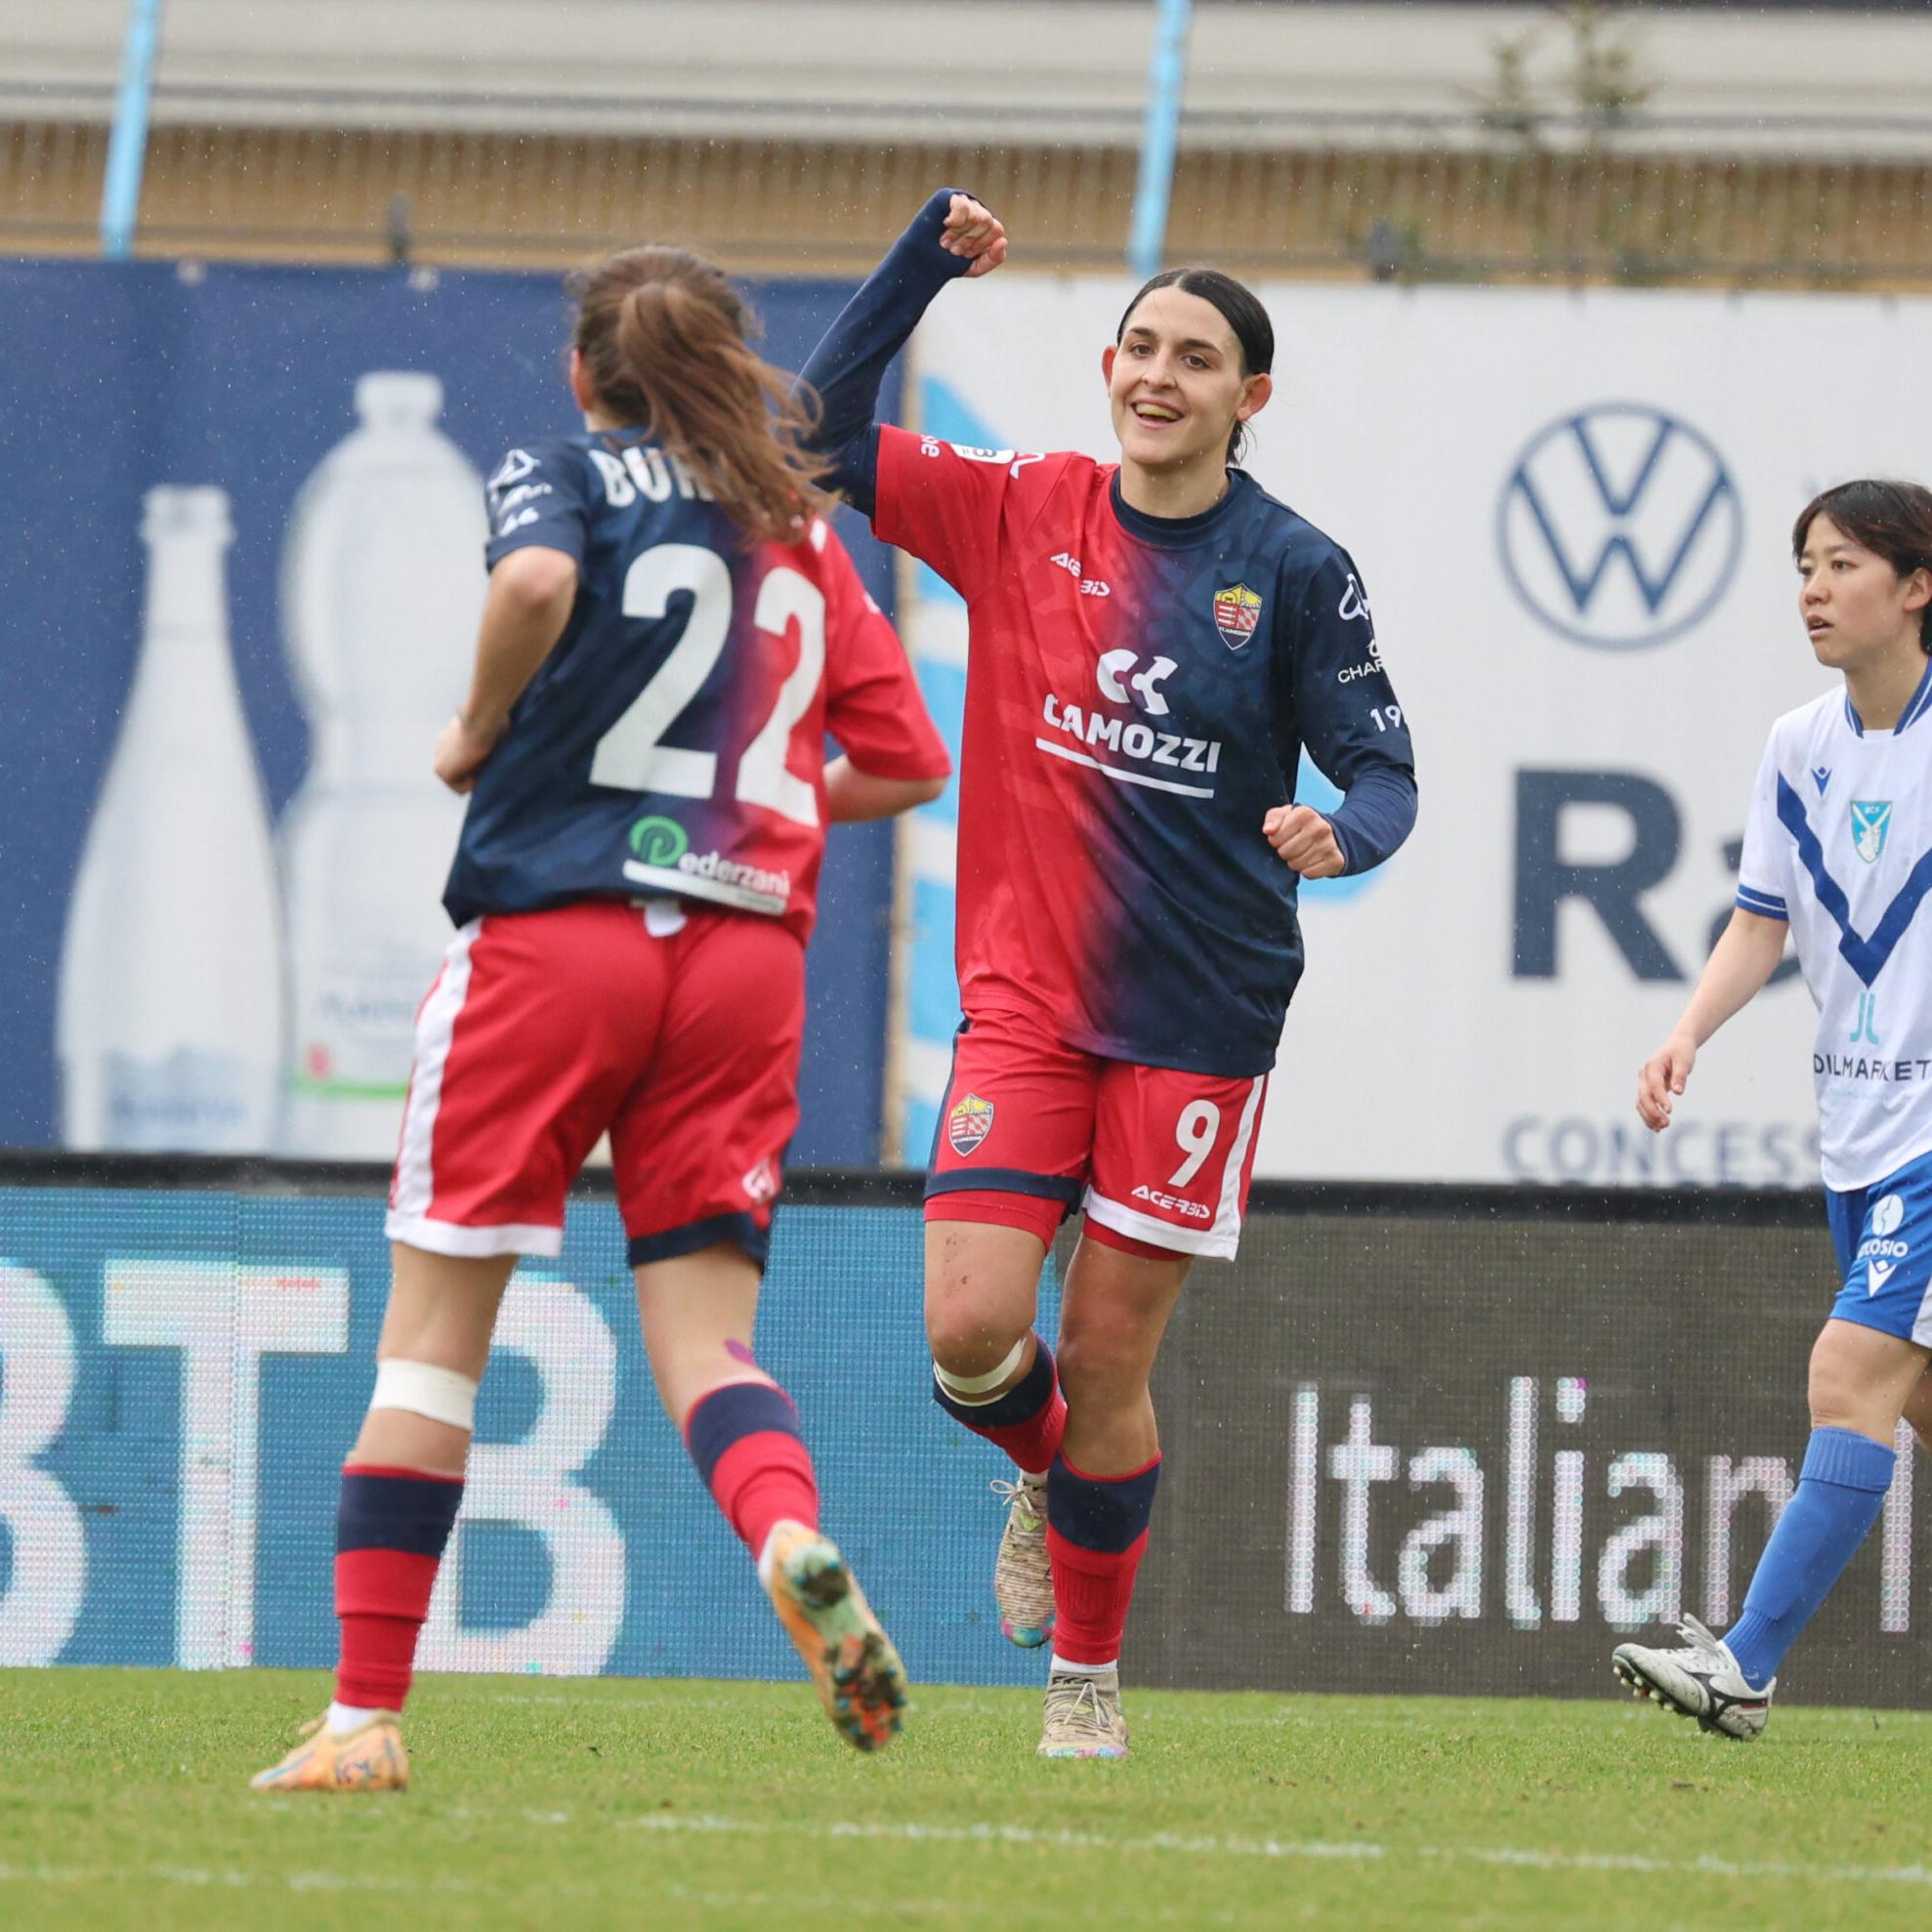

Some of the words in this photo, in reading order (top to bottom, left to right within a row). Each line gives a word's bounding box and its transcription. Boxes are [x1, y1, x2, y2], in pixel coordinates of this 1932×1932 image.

[589, 542, 826, 828] 22
[1043, 693, 1221, 773] CAMOZZI
[629, 815, 791, 900] Pederzani
[1168, 1099, 1221, 1188] 9
[1283, 1375, 1795, 1631] Italian
